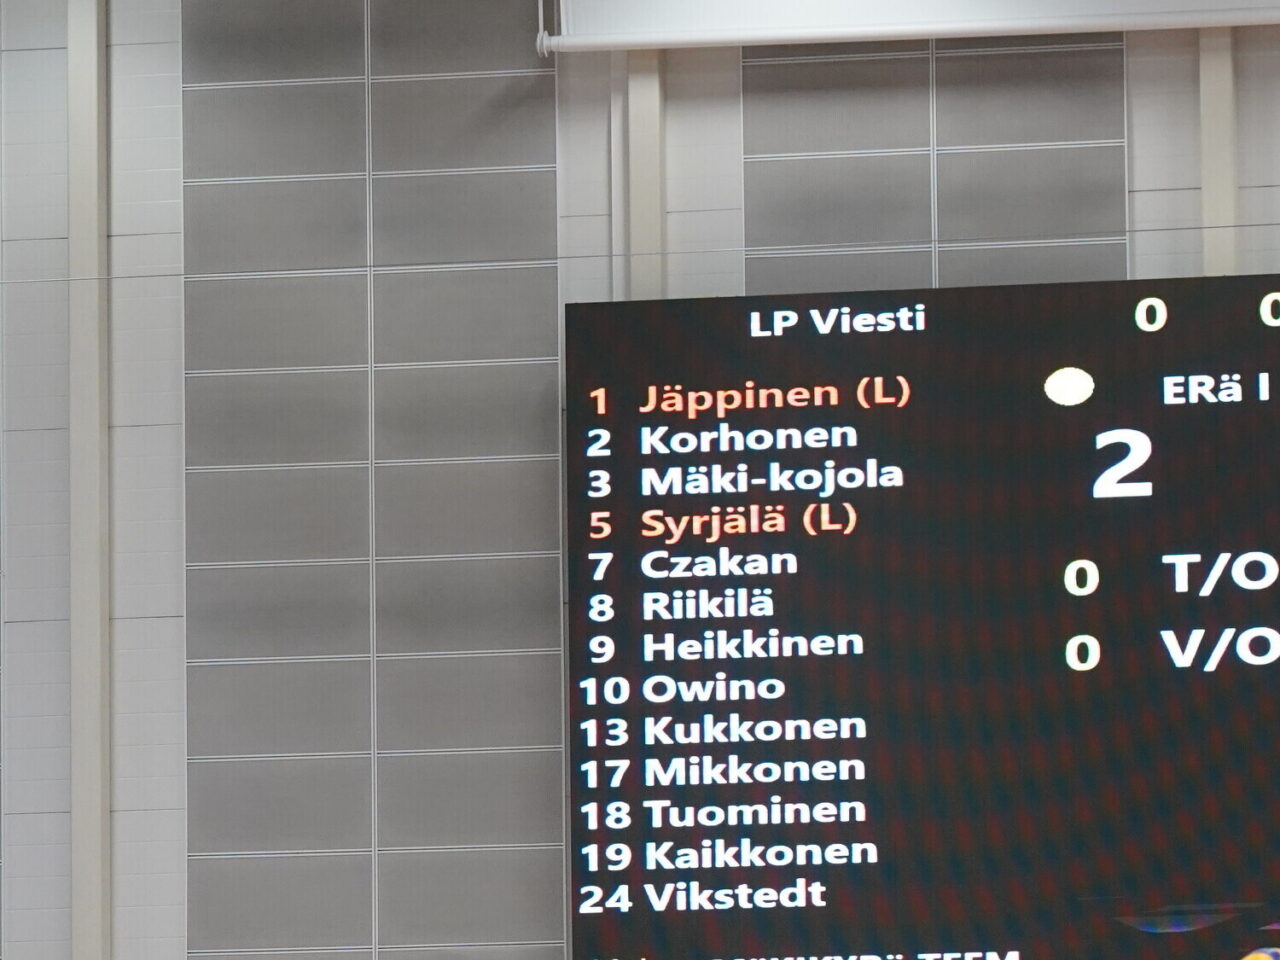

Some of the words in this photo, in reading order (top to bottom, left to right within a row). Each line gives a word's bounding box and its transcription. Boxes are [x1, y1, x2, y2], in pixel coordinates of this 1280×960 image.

[751, 311, 798, 337] LP
[809, 304, 925, 334] Viesti
[1135, 298, 1167, 331] 0
[590, 388, 605, 414] 1
[639, 381, 838, 419] Jäppinen
[857, 376, 910, 408] (L)
[1164, 374, 1242, 404] ERä
[587, 429, 611, 456] 2
[641, 423, 857, 454] Korhonen
[588, 470, 611, 497] 3
[642, 458, 903, 497] Mäki-kojola
[1093, 429, 1152, 498] 2
[590, 512, 611, 539] 5
[642, 504, 785, 544] Syrjälä
[803, 503, 857, 536] (L)
[588, 552, 613, 580] 7
[641, 547, 797, 578] Czakan
[1064, 559, 1099, 596] 0
[1162, 552, 1279, 596] T/O
[589, 594, 614, 622] 8
[643, 588, 773, 620] Riikilä
[589, 636, 615, 663] 9
[644, 628, 863, 661] Heikkinen
[1065, 635, 1100, 671] 0
[580, 677, 630, 705] 10
[642, 672, 785, 703] Owino
[580, 718, 629, 747] 13
[645, 713, 866, 745] Kukkonen
[581, 759, 630, 788] 17
[645, 755, 865, 786] Mikkonen
[581, 801, 631, 830] 18
[643, 795, 866, 828] Tuominen
[581, 843, 632, 871] 19
[646, 838, 877, 870] Kaikkonen
[579, 885, 633, 913] 24
[644, 878, 826, 911] Vikstedt
